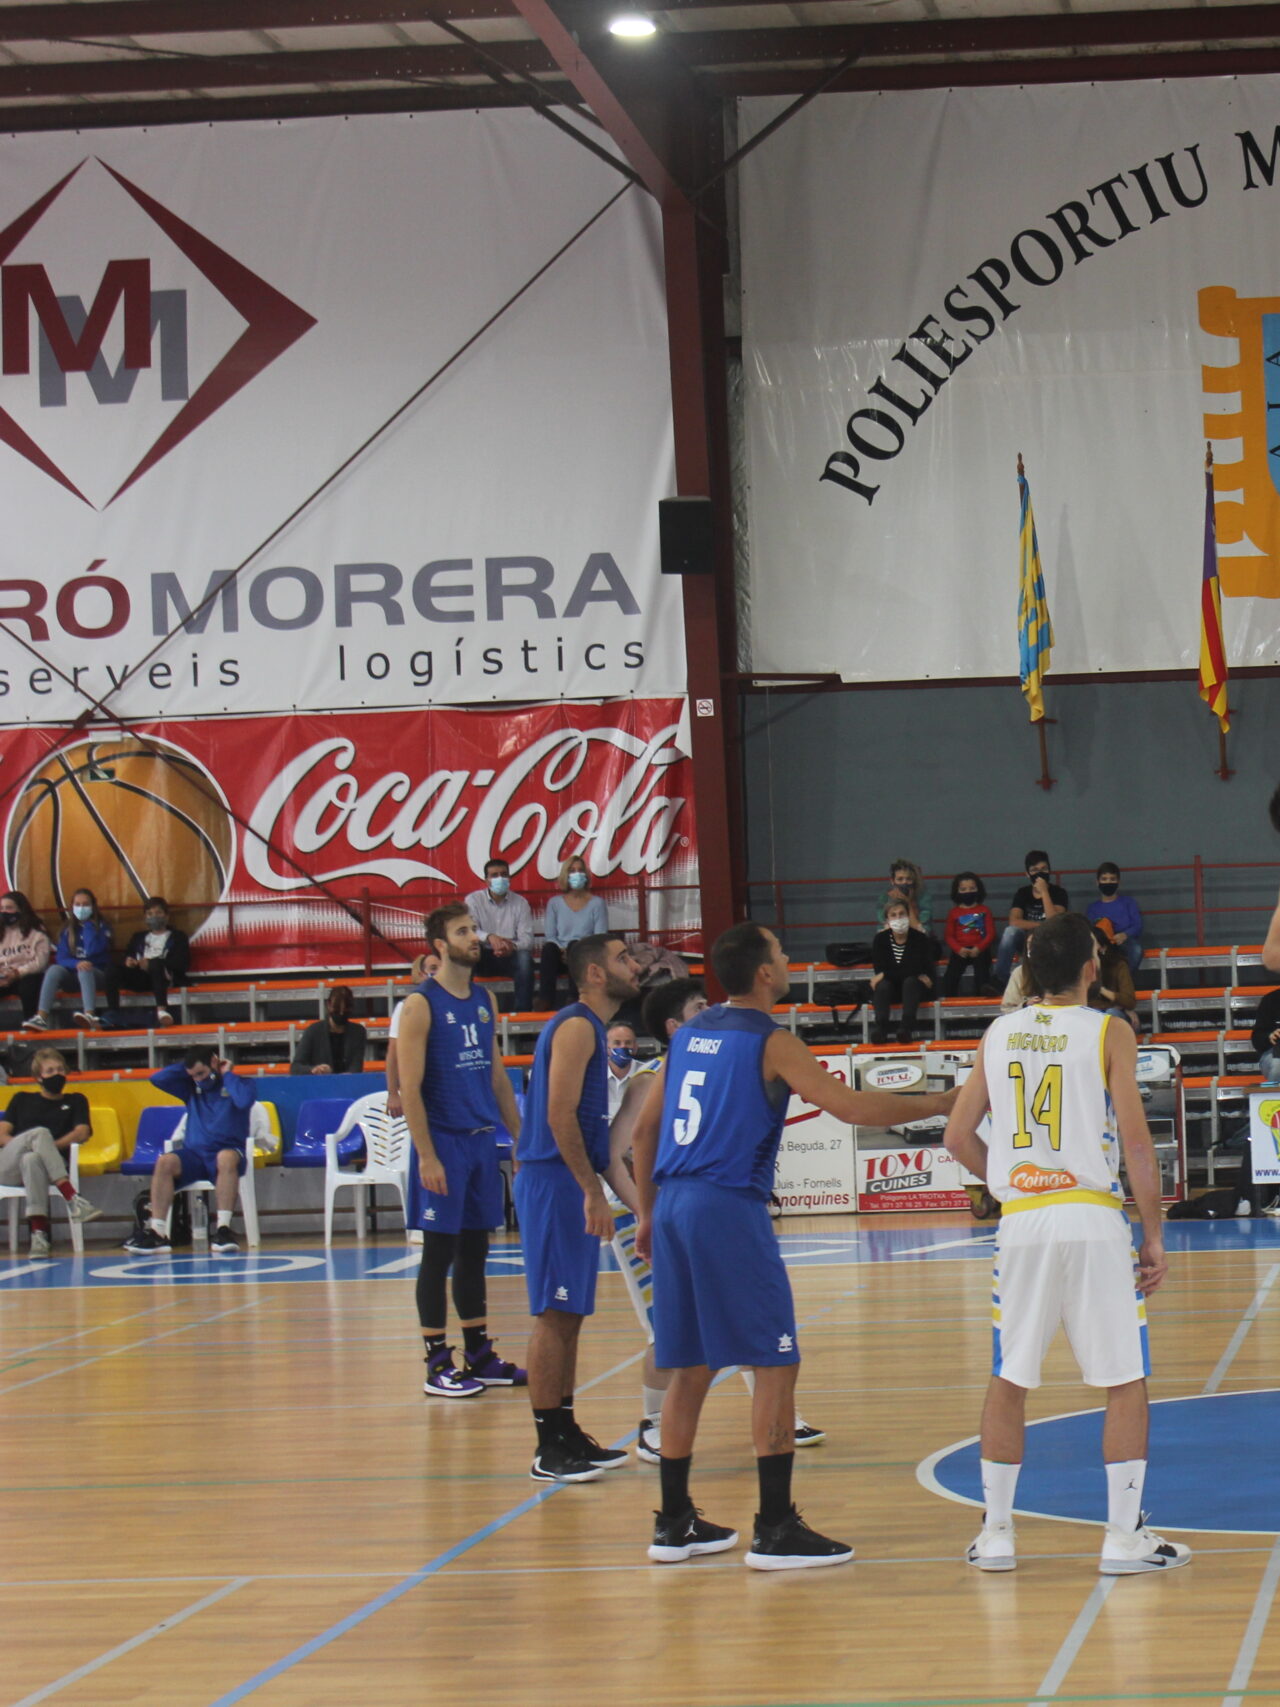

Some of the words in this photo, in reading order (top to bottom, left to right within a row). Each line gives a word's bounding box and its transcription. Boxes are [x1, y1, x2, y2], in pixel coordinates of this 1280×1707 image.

[819, 143, 1209, 506] POLIESPORTIU
[150, 551, 642, 637] MORERA
[337, 636, 645, 685] logístics
[242, 724, 685, 891] Coca-Cola
[686, 1036, 722, 1055] IGNASI
[673, 1070, 707, 1146] 5
[1008, 1061, 1063, 1152] 14
[830, 1139, 843, 1151] 27
[863, 1149, 933, 1181] TOYO
[768, 1190, 850, 1209] norquines
[803, 1177, 843, 1189] Fornells
[870, 1174, 928, 1193] CUINES
